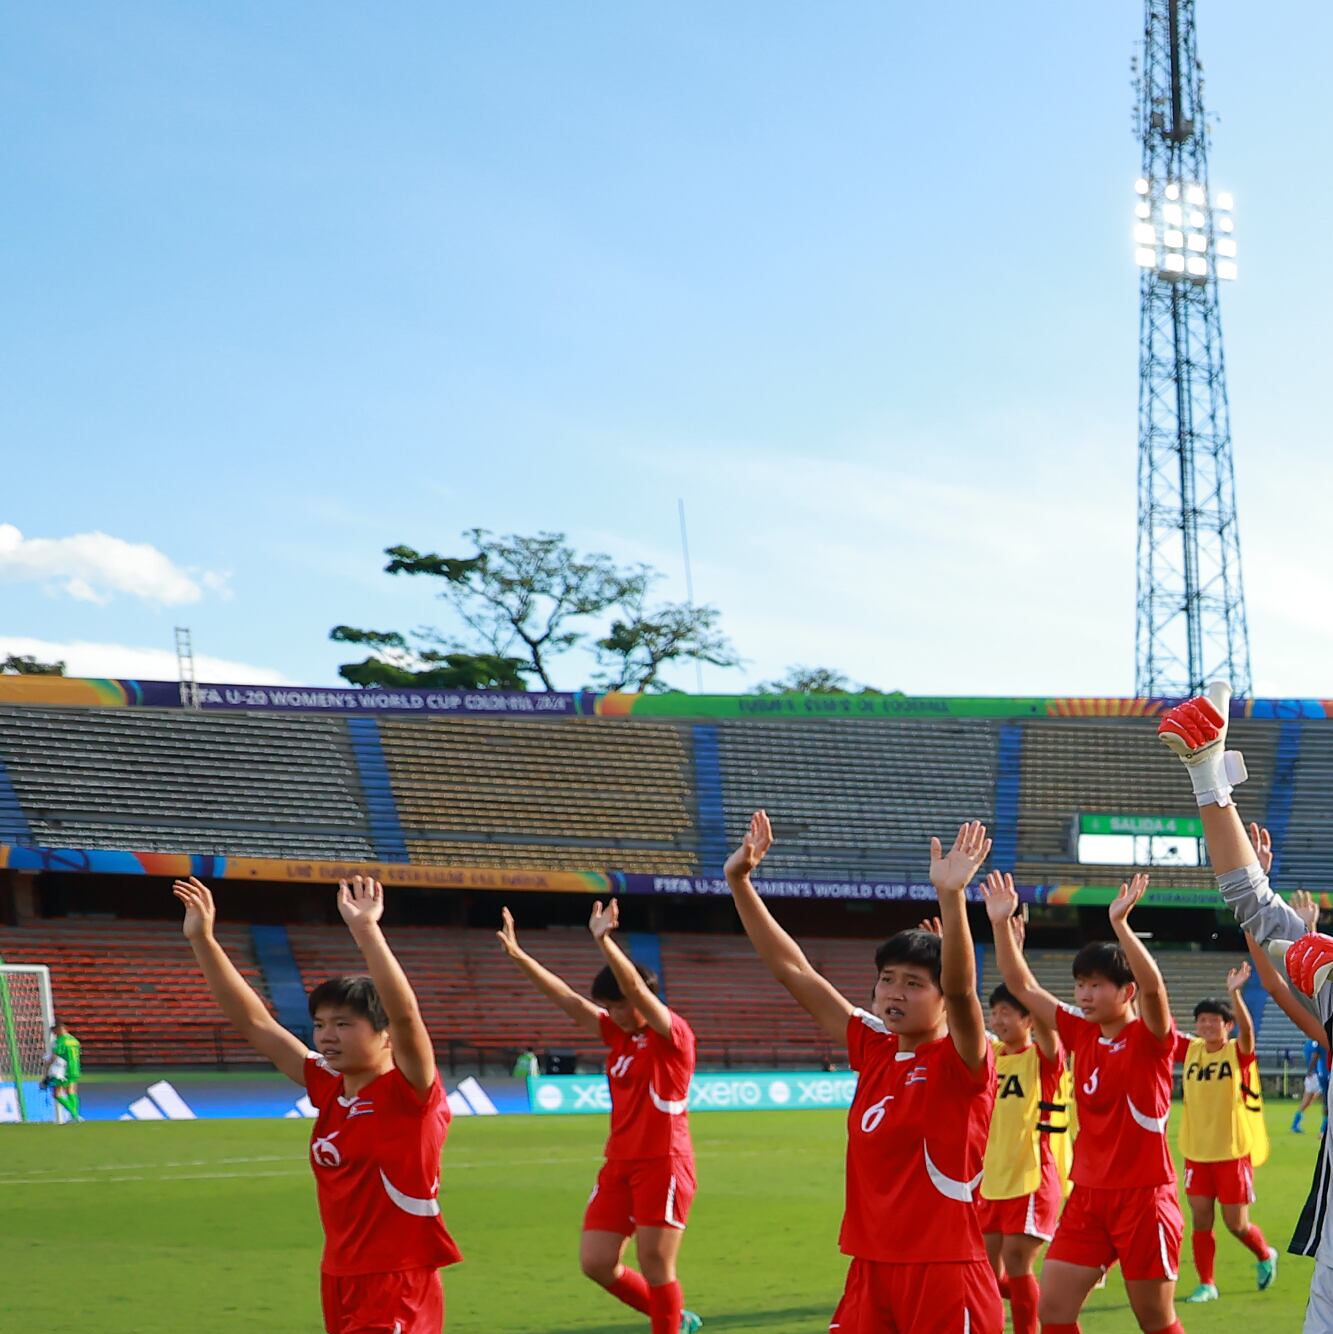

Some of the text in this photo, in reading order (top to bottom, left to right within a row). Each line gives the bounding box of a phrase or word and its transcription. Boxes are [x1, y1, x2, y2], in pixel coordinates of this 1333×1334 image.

[269, 691, 358, 708] WOMEN'S
[359, 693, 422, 709] WORLD
[426, 694, 462, 709] CUP
[1110, 817, 1177, 832] SALIDA 4
[653, 877, 693, 893] FIFA
[814, 883, 873, 898] WORLD
[874, 884, 907, 899] CUP
[1186, 1061, 1233, 1082] FIFA
[692, 1081, 761, 1105] xero
[860, 1095, 894, 1133] 6
